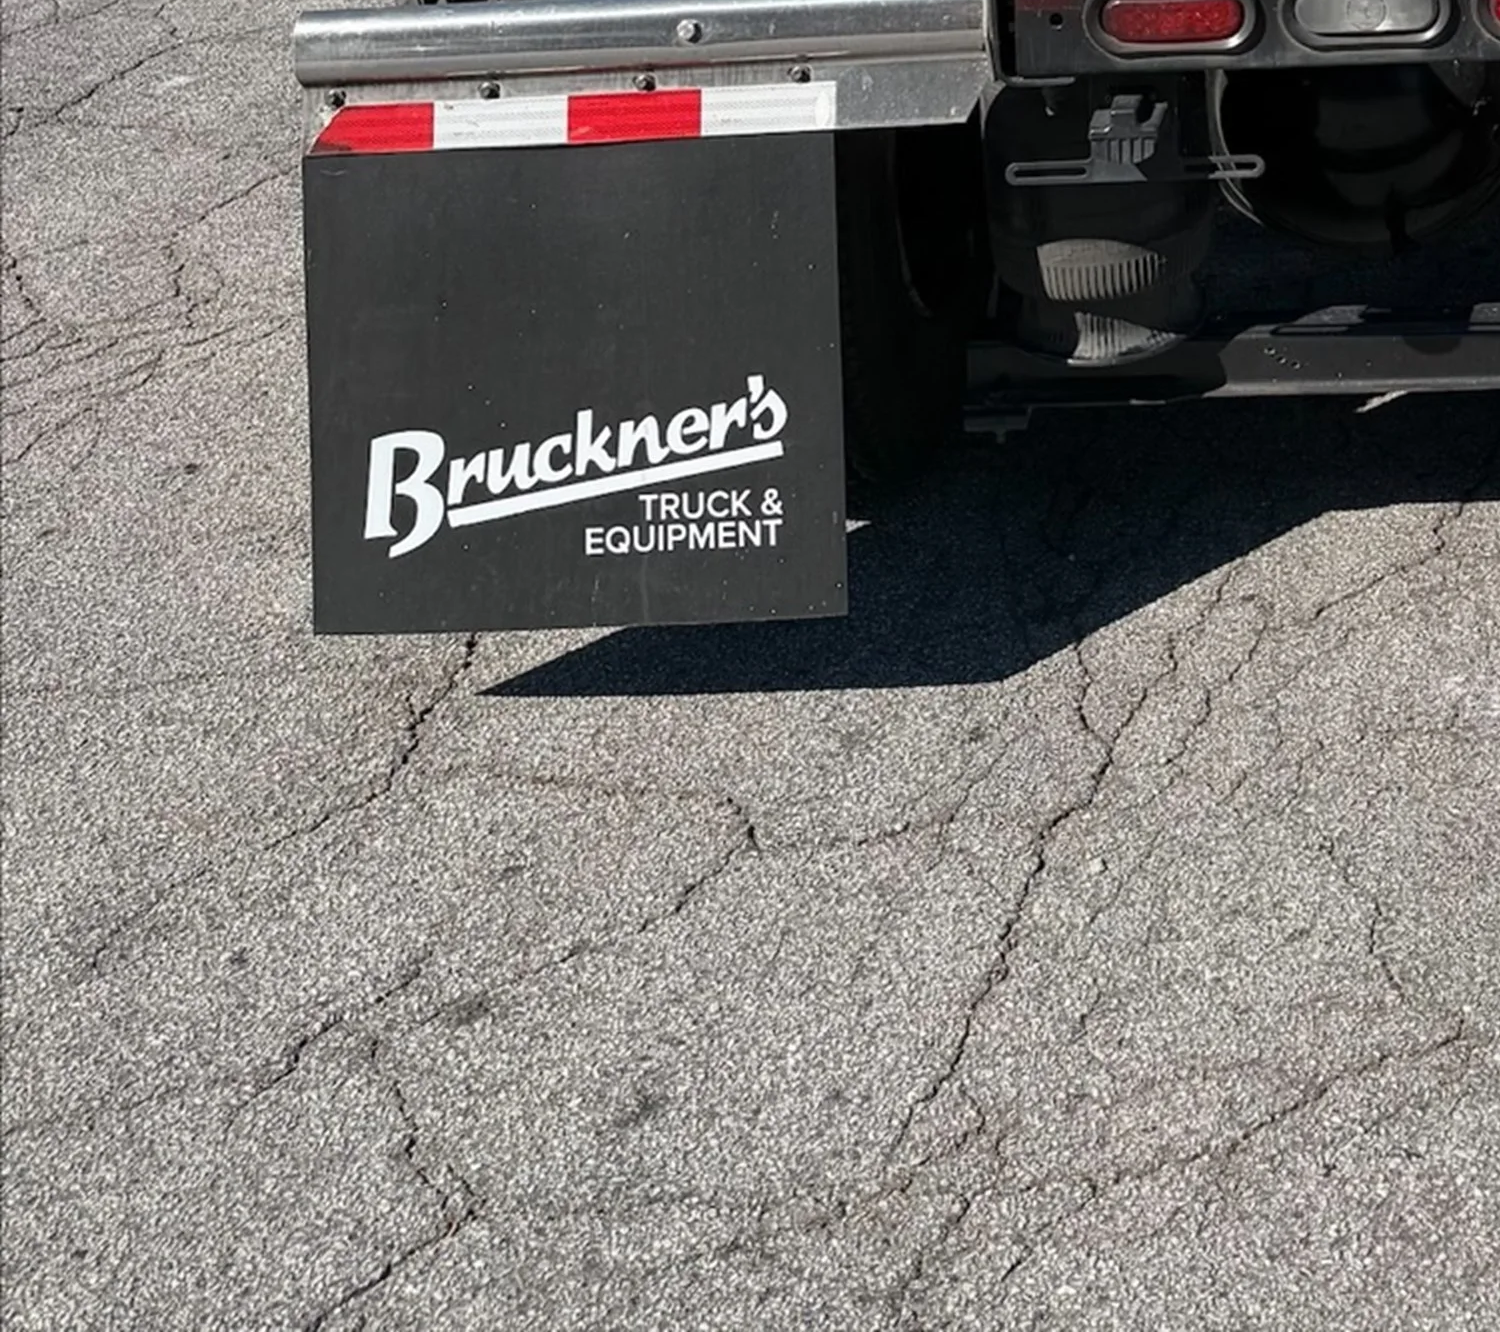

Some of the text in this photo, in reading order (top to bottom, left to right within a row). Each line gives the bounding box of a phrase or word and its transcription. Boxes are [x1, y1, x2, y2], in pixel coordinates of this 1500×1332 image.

[364, 374, 788, 558] Bruckner's
[638, 487, 784, 522] TRUCK &
[584, 519, 784, 556] EQUIPMENT
